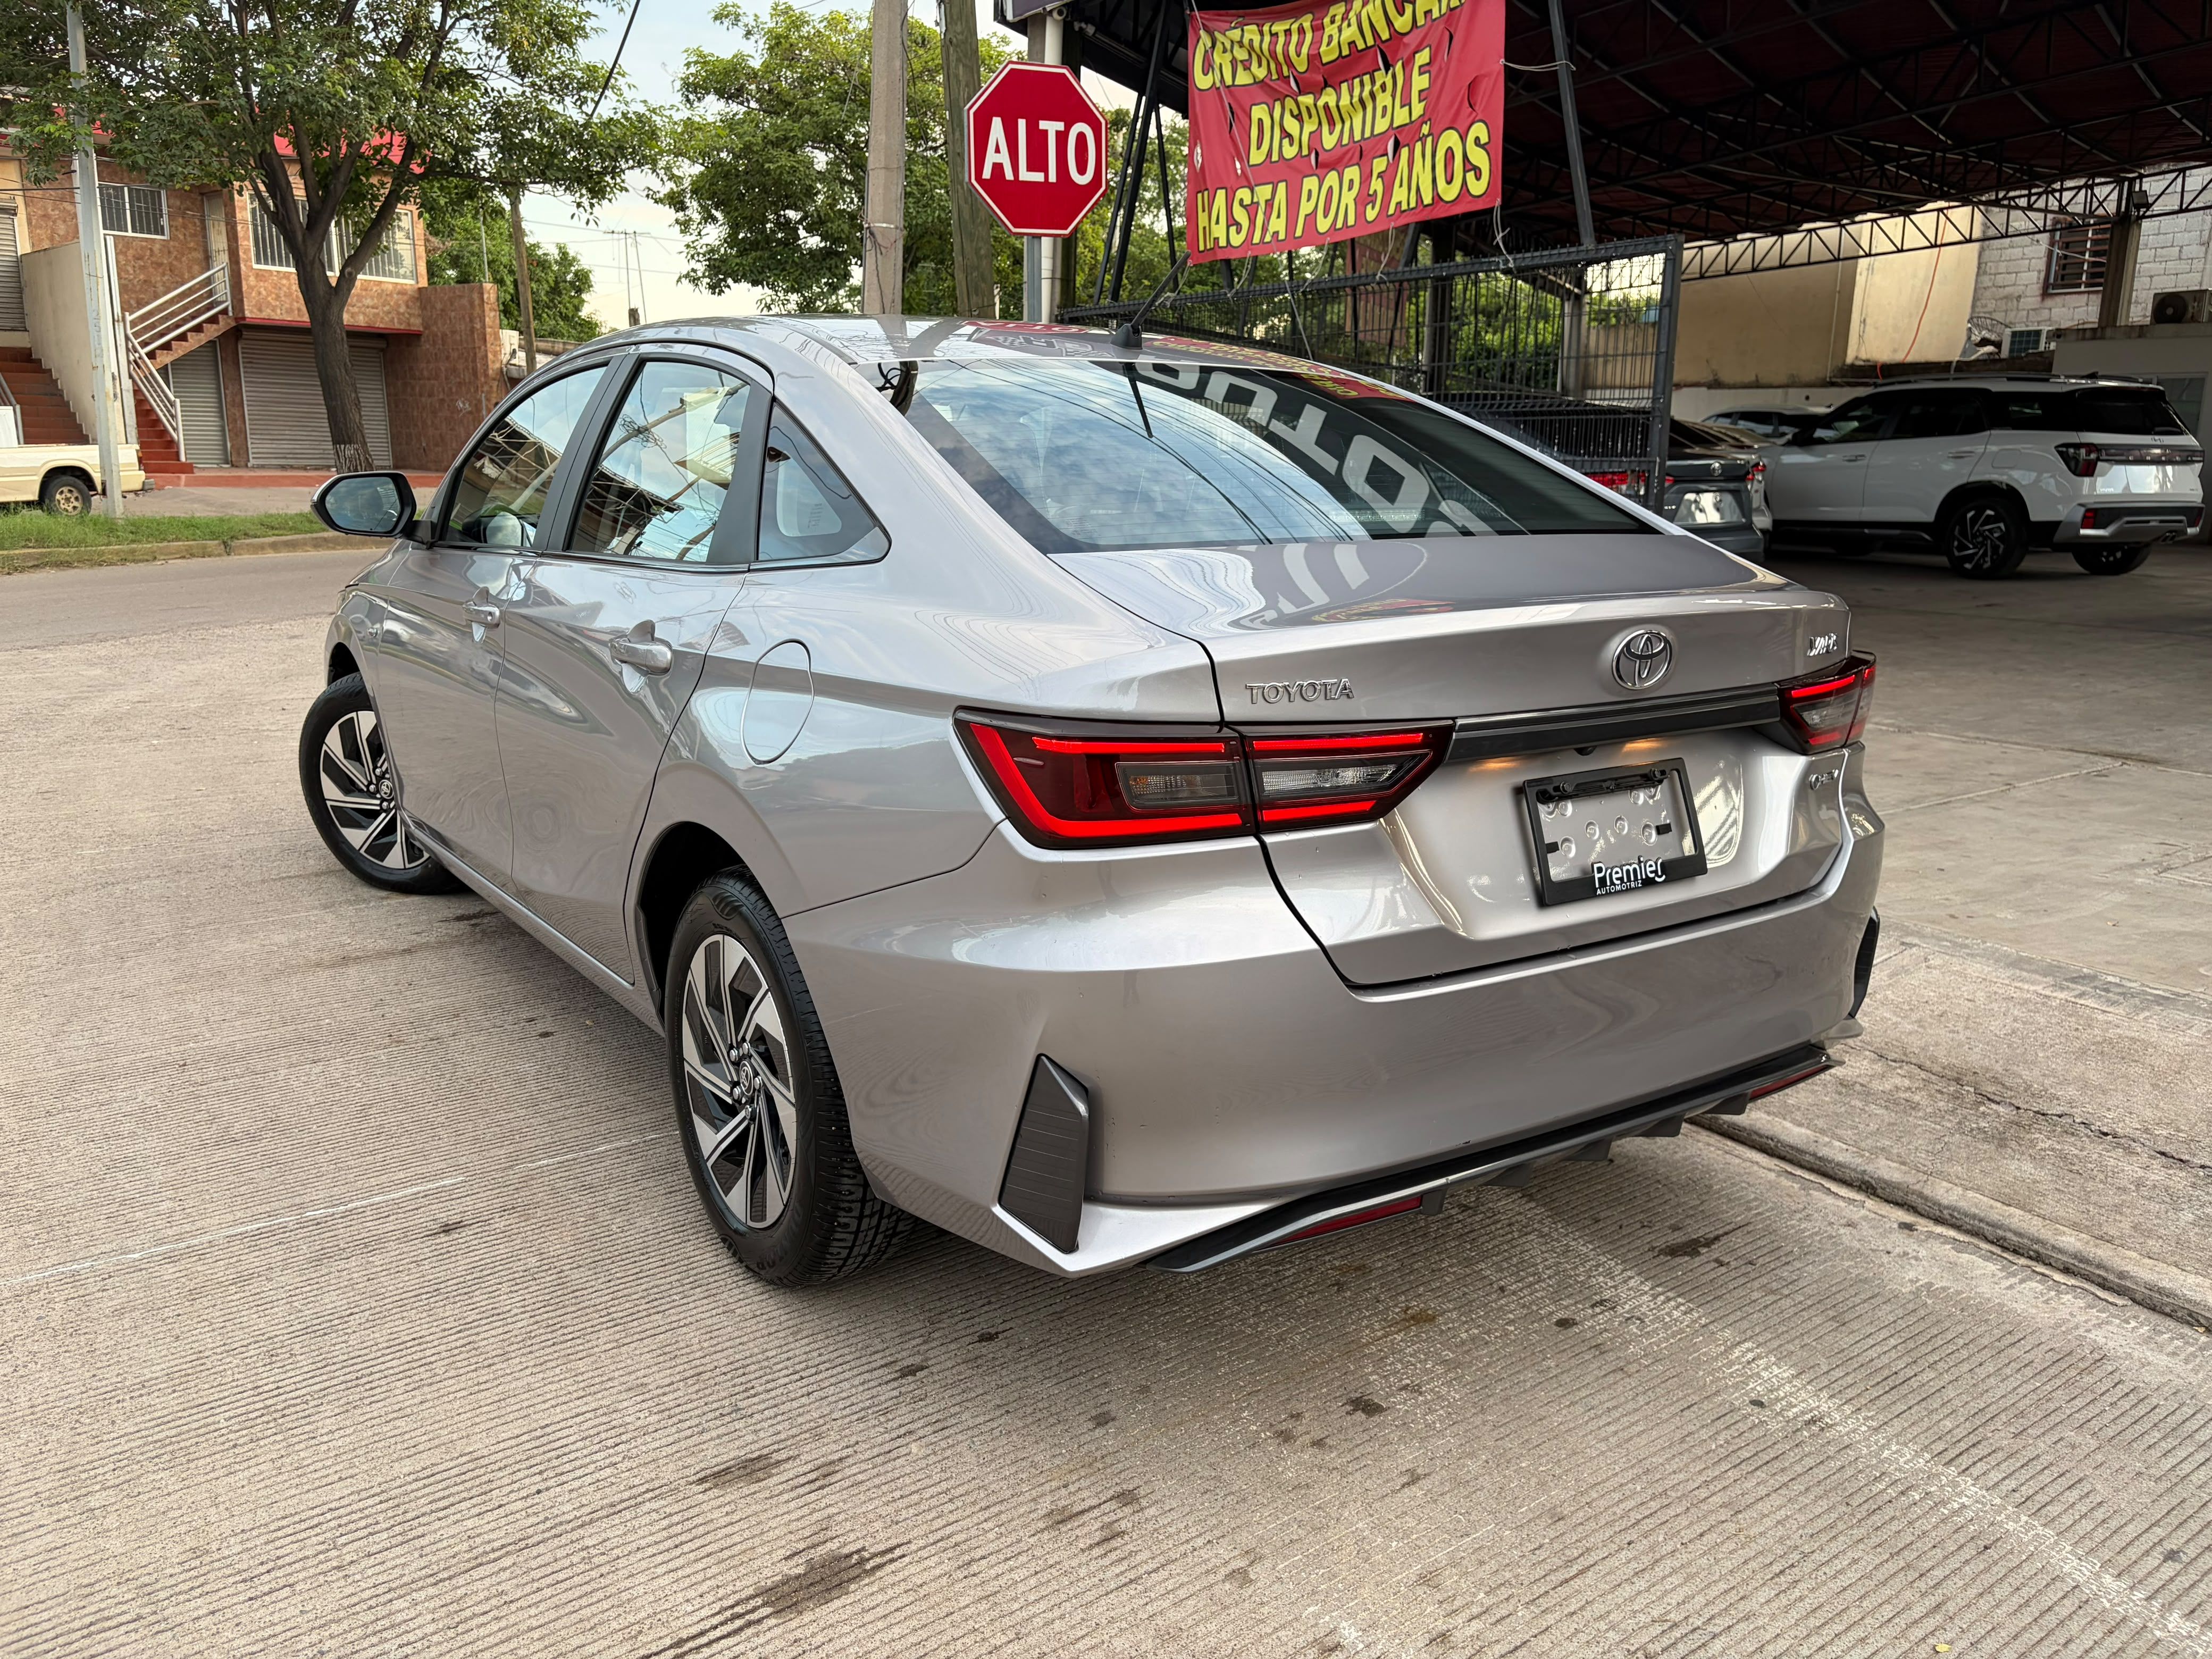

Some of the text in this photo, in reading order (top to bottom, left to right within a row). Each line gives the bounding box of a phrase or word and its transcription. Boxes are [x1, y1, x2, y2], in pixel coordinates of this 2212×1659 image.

[1193, 0, 1466, 90] CRÉDITO BANC
[1248, 45, 1432, 166] DISPONIBLE
[982, 116, 1096, 186] ALTO
[1196, 119, 1491, 253] HASTA POR 5 AÑOS
[1245, 678, 1355, 705] TOYOTA
[1593, 856, 1666, 888] Premier
[1596, 879, 1643, 895] AUTOMOTRIZ
